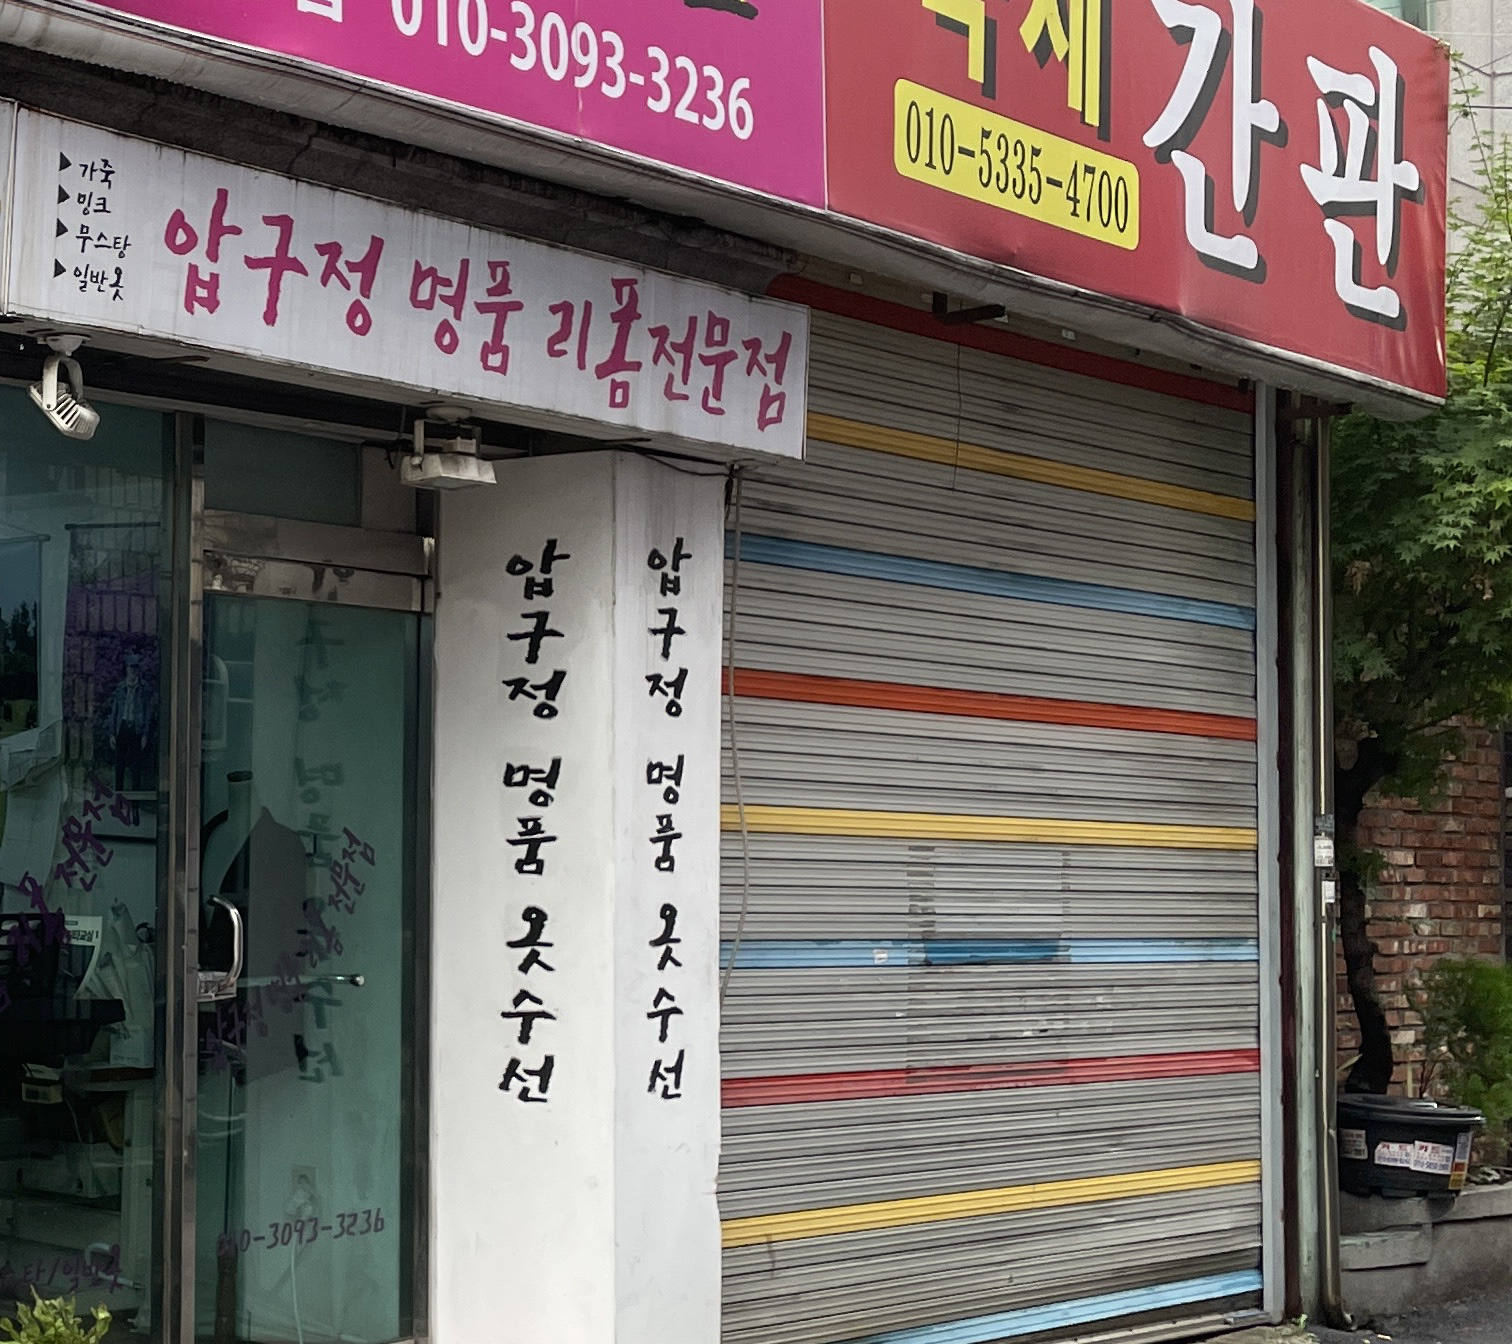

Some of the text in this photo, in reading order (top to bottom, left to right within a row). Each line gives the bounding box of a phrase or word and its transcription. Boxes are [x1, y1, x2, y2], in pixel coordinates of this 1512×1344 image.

[77, 191, 112, 216] 밍크
[79, 158, 116, 190] 가죽
[906, 101, 1130, 234] 010-5335-4700
[73, 263, 125, 301] 일반옷
[75, 223, 132, 258] 무스탕
[163, 187, 386, 337] 압구정
[409, 256, 525, 377] 명품
[498, 538, 571, 1103] 압구정 명품 옷수선
[646, 537, 692, 1099] 압구정 명품 옷수선
